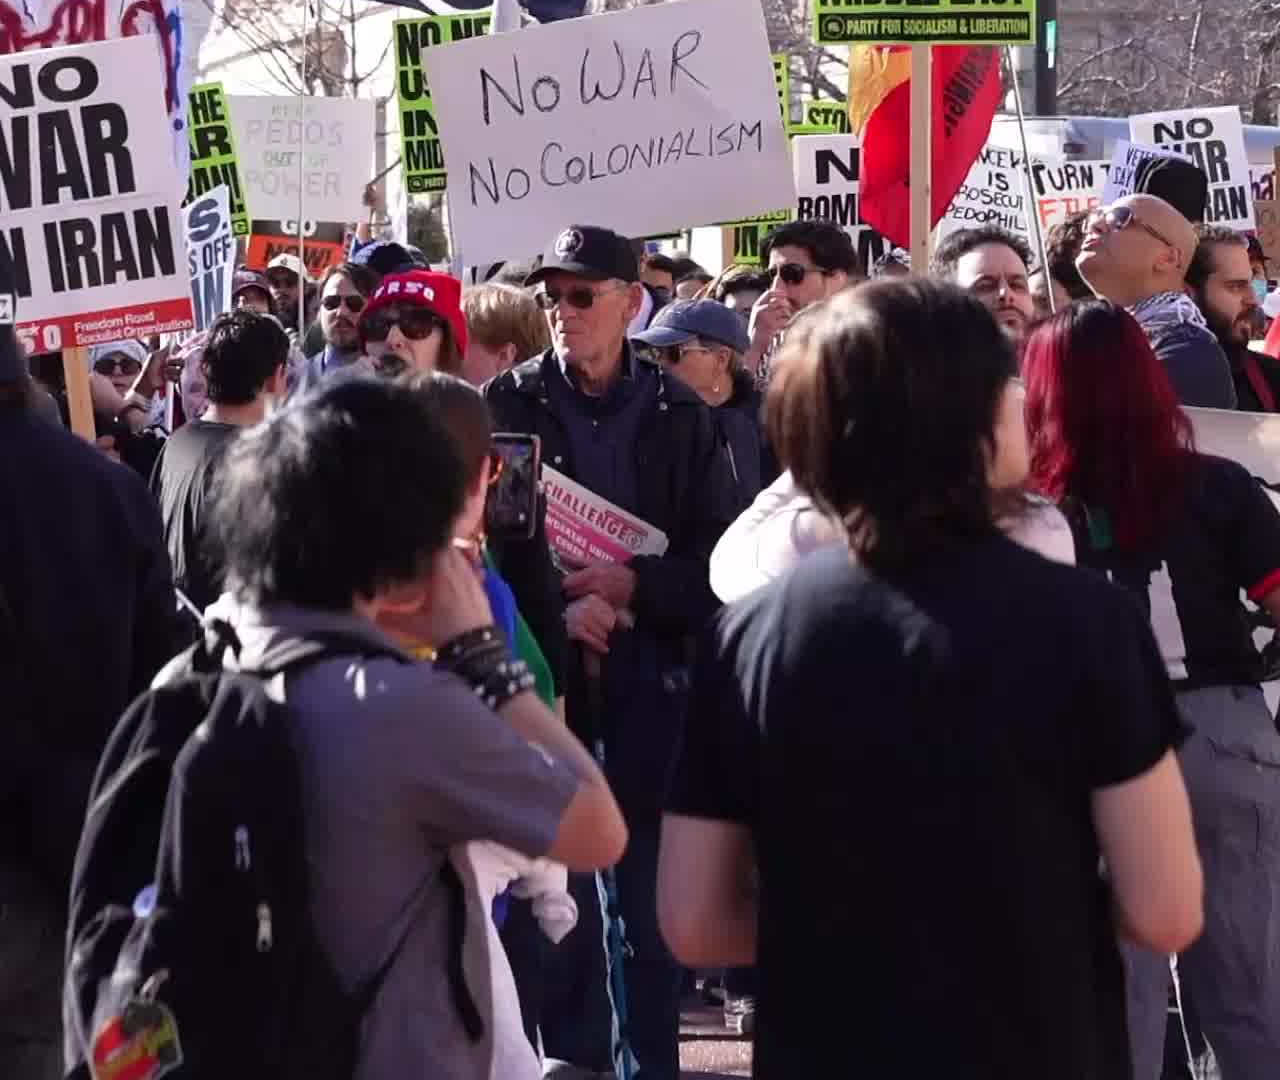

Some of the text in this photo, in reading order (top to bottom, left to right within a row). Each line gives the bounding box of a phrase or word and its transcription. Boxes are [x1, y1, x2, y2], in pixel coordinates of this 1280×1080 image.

[846, 19, 879, 35] PARTY
[881, 19, 901, 35] FOR
[903, 19, 957, 35] SOCIALISM
[970, 19, 1027, 35] LIBERATION
[580, 29, 711, 104] WAR
[188, 88, 225, 124] HE
[1153, 118, 1214, 144] NO
[987, 171, 1009, 191] IS
[43, 206, 176, 293] IRAN
[203, 234, 231, 270] OFF
[74, 317, 124, 333] Freedom
[124, 319, 193, 338] Organization
[543, 480, 628, 541] CHALLENGE
